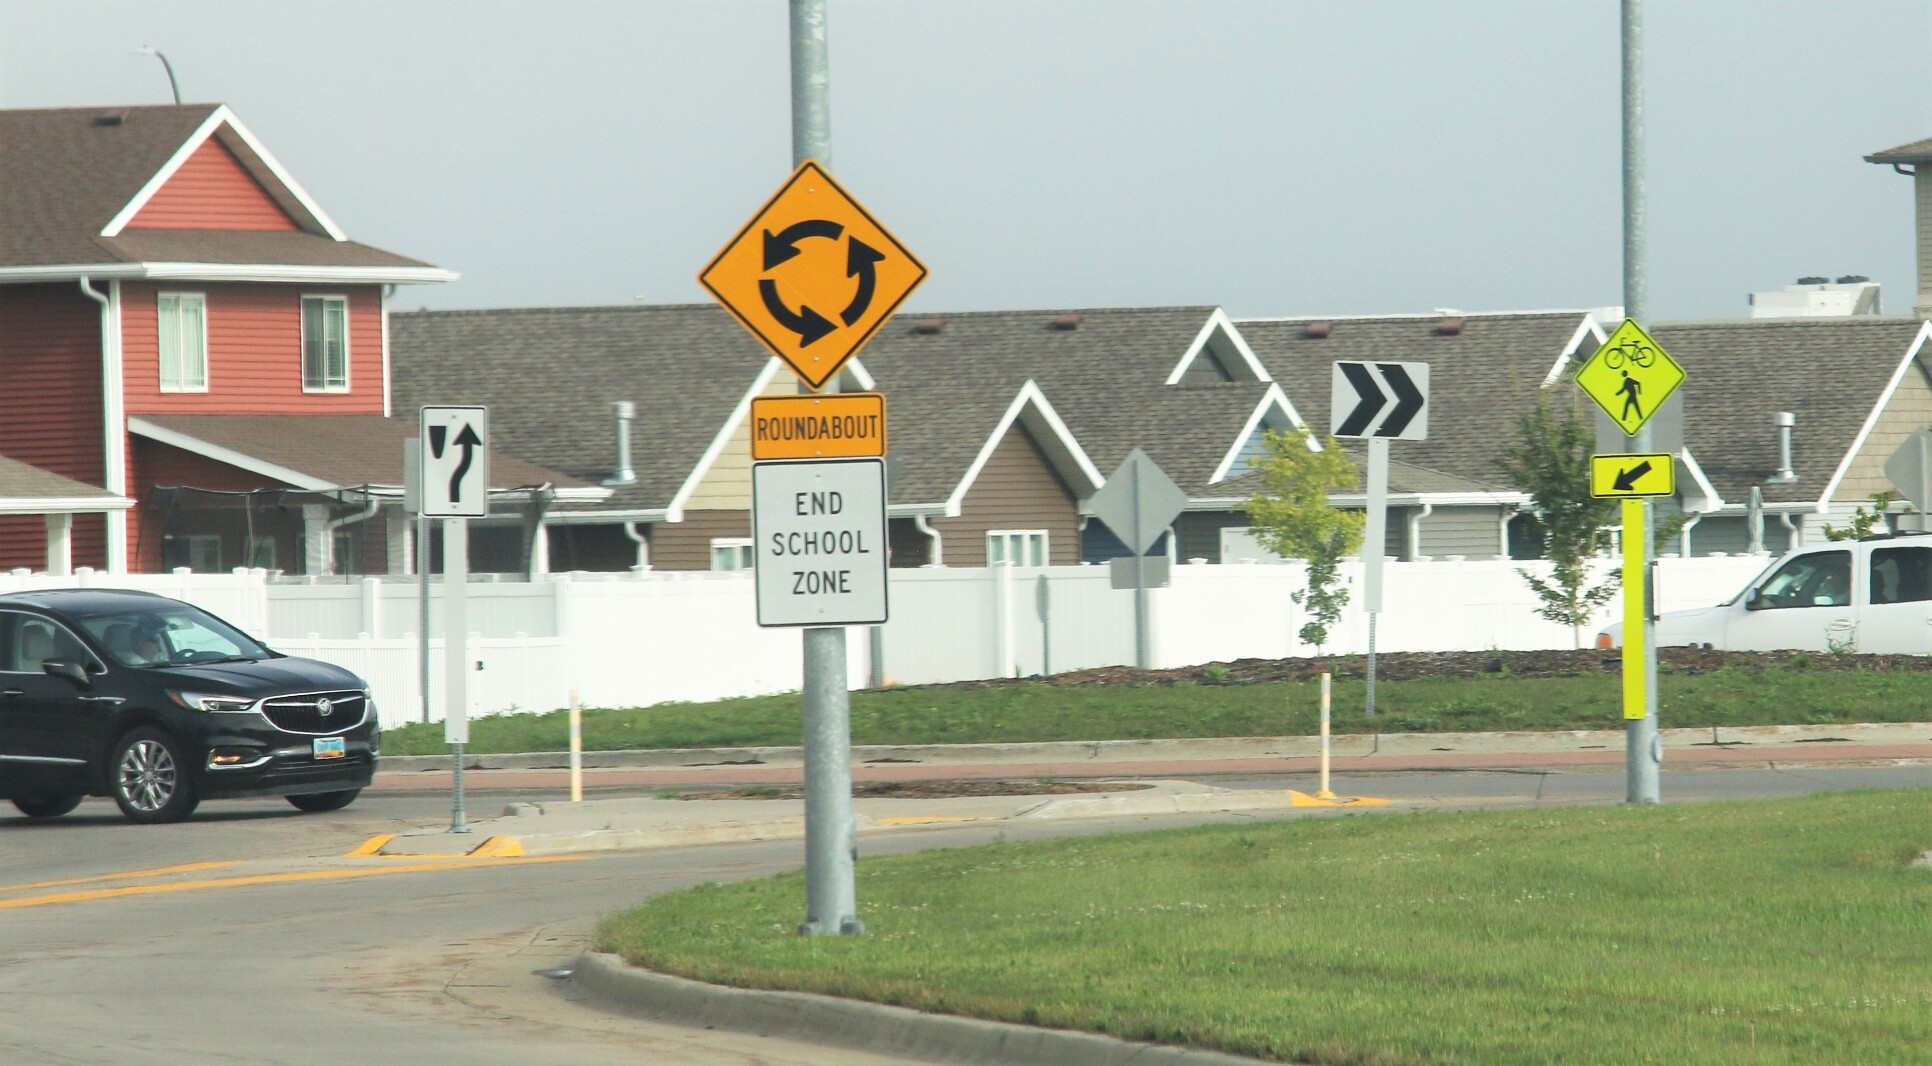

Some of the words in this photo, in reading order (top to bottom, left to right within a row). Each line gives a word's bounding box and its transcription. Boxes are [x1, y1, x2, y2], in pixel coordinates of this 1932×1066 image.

[757, 415, 877, 441] ROUNDABOUT
[796, 491, 843, 516] END
[771, 530, 870, 556] SCHOOL
[792, 570, 852, 595] ZONE
